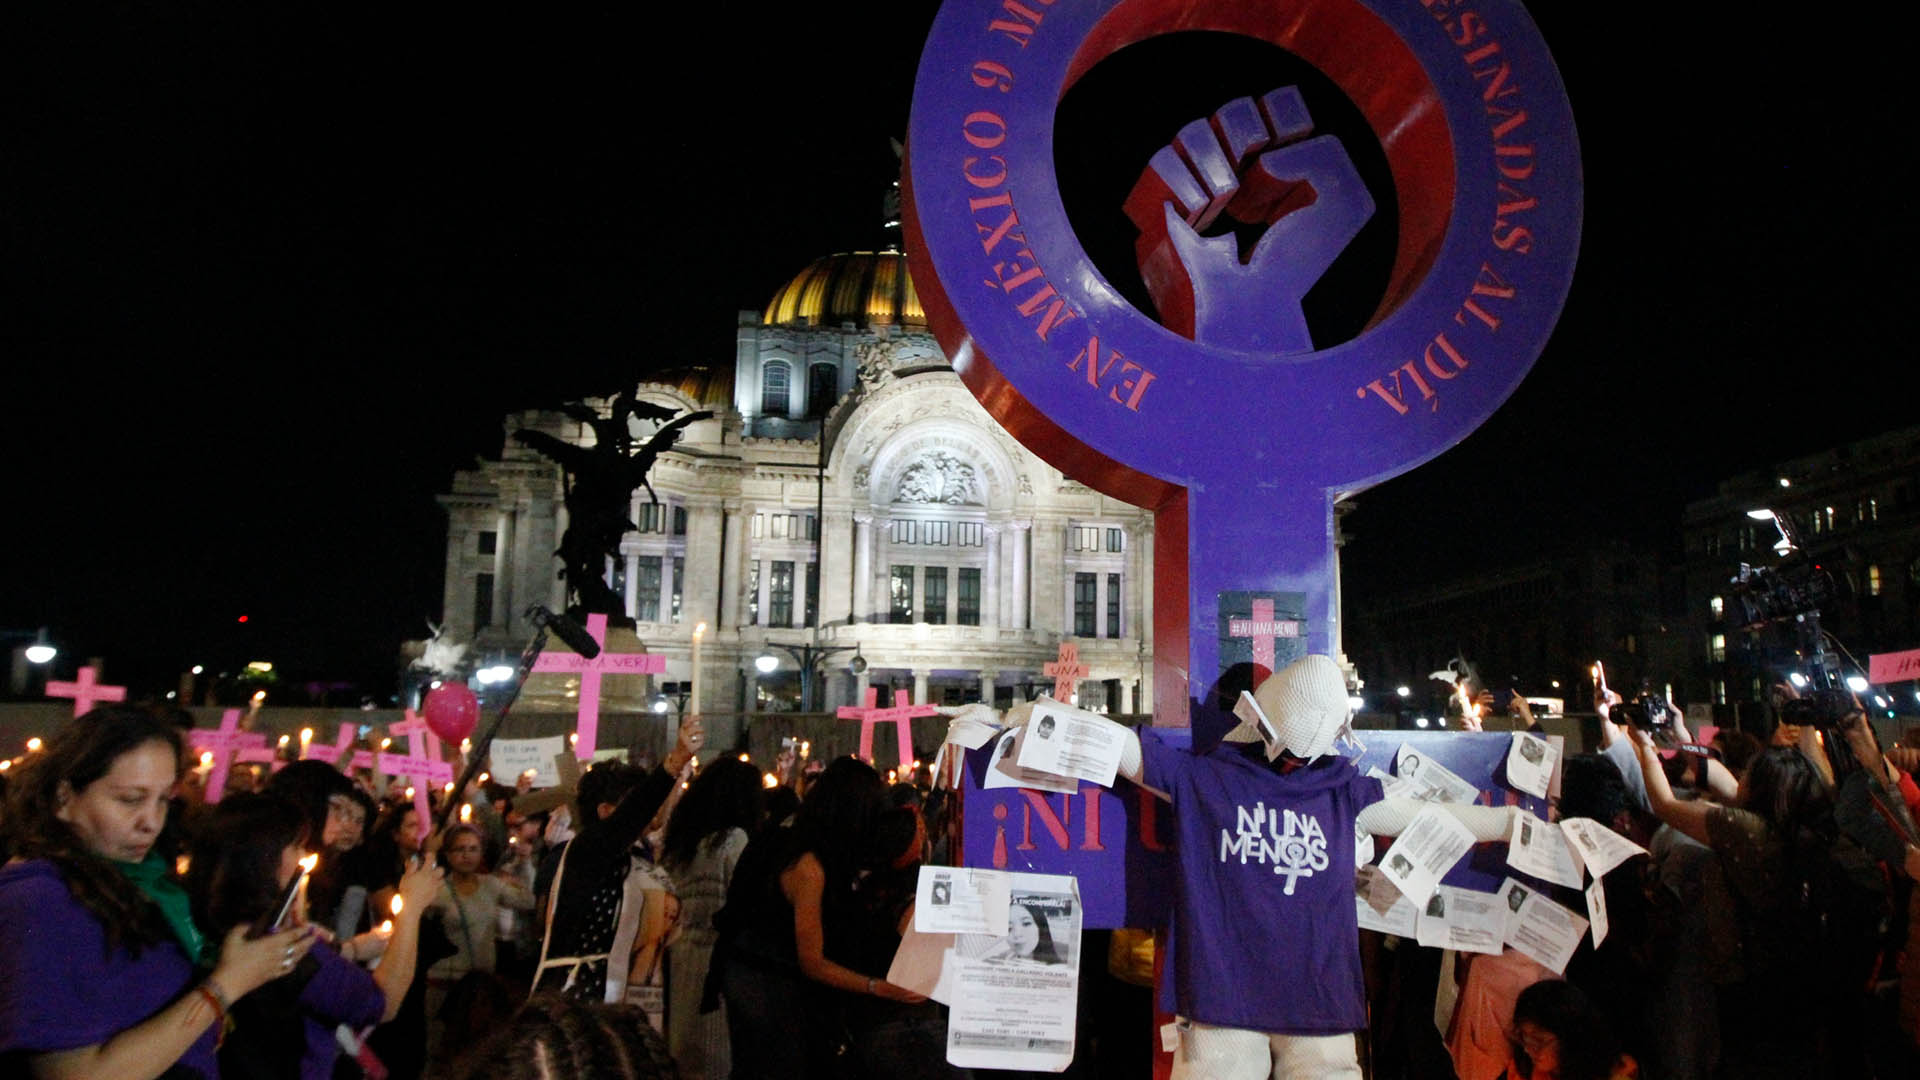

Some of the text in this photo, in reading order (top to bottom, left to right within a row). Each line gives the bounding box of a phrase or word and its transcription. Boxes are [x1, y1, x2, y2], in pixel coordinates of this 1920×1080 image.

[988, 0, 1058, 48] M
[972, 61, 1014, 94] 9
[963, 111, 1077, 341] MÉXICO
[1455, 262, 1515, 331] AL
[1065, 336, 1157, 412] EN
[1356, 332, 1469, 415] DÍA.
[1220, 828, 1329, 876] MENOS
[1237, 801, 1327, 849] NI UNA
